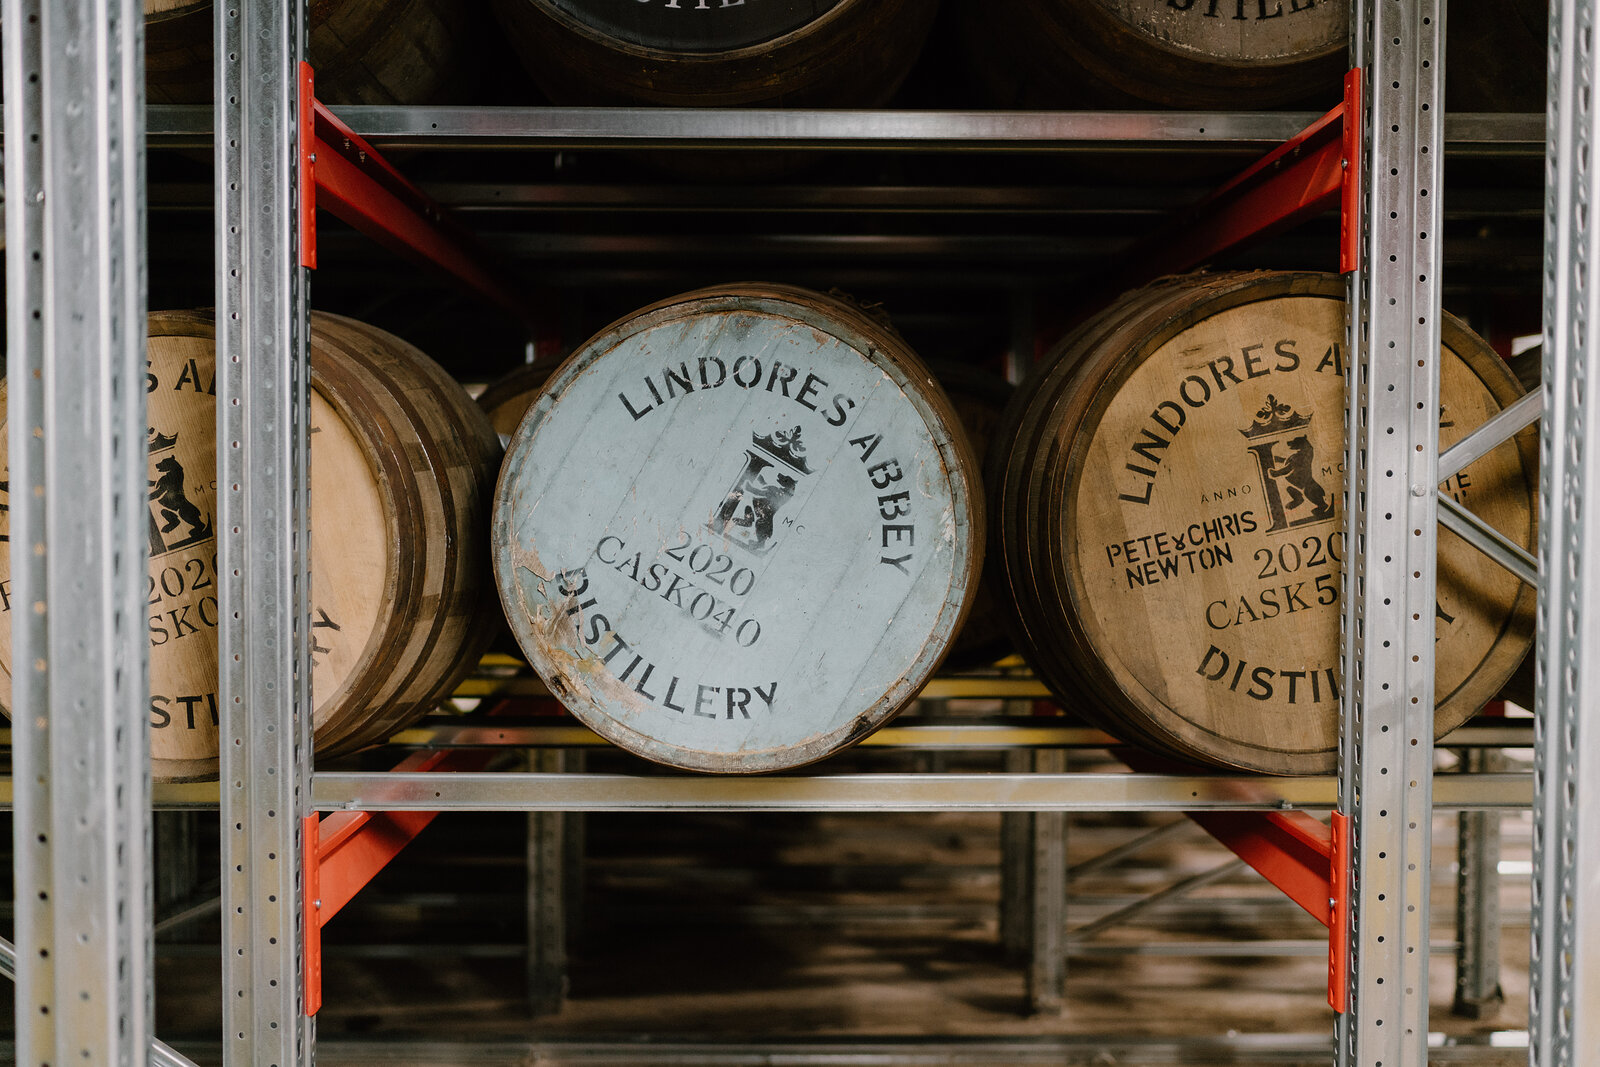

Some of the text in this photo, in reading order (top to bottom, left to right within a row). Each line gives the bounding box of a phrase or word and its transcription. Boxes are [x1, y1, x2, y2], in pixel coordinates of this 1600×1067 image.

[1118, 339, 1301, 506] LINDORES
[618, 355, 915, 577] LINDORES ABBEY
[1201, 485, 1252, 504] ANNO
[147, 552, 218, 605] 202
[665, 531, 756, 597] 2020
[1125, 542, 1234, 590] NEWTON
[1205, 572, 1342, 631] CASK5
[555, 567, 778, 720] DISTILLERY
